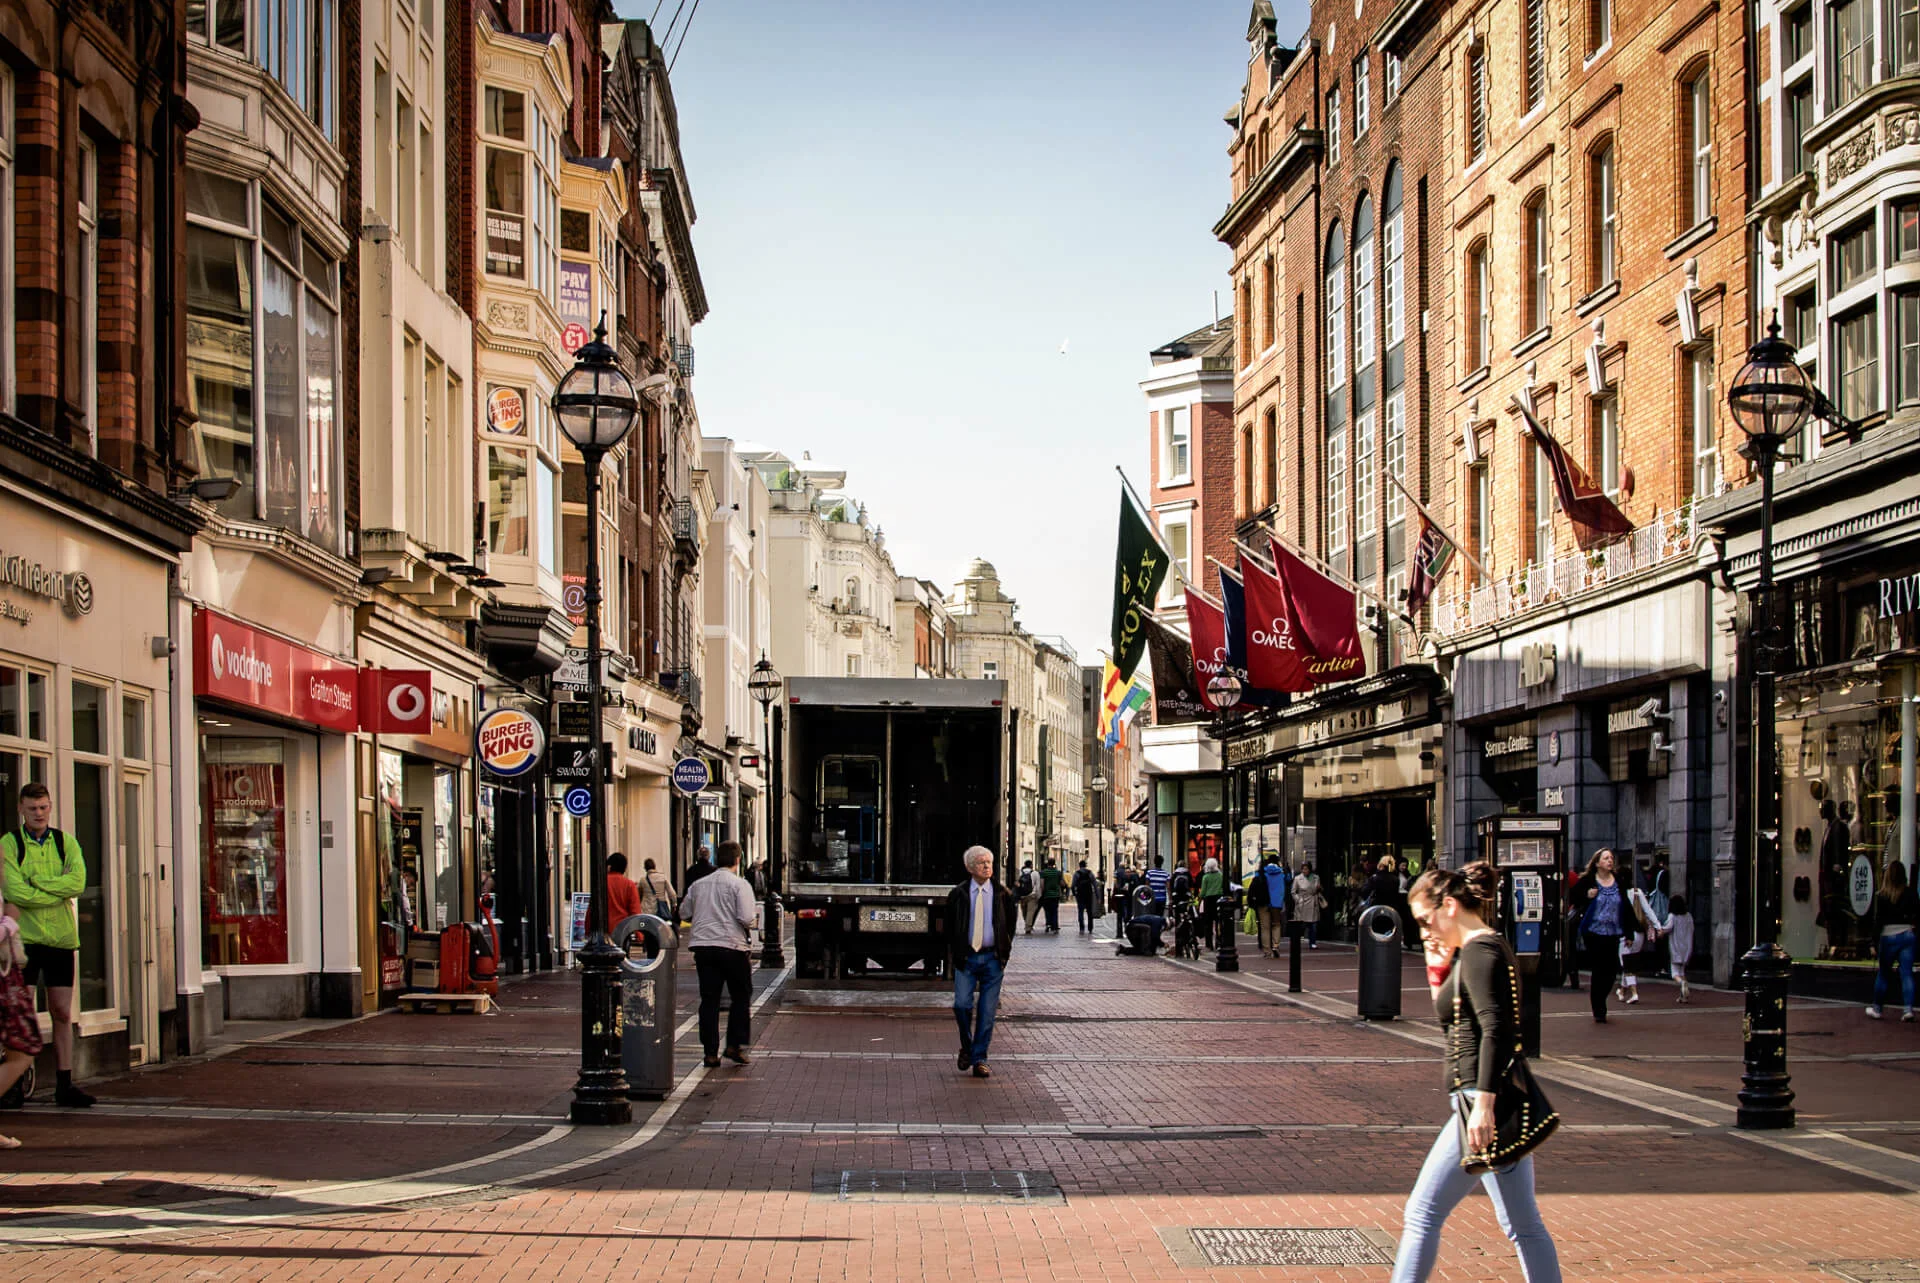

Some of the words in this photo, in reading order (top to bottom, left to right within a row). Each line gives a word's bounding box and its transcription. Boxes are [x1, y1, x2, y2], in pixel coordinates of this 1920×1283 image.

[561, 271, 588, 289] PAY
[573, 289, 588, 299] YOU
[561, 300, 588, 318] TAN
[26, 560, 65, 601] Ireland
[1879, 572, 1920, 619] RIV
[1519, 642, 1557, 688] AIB
[226, 646, 272, 687] vodafone
[310, 676, 334, 705] Grafton
[333, 684, 352, 710] Street
[482, 722, 532, 744] BURGER
[484, 733, 534, 761] KING
[1486, 738, 1508, 757] Service
[1508, 735, 1529, 751] Centre
[676, 774, 706, 784] MATTERS
[678, 765, 704, 774] HEALTH
[223, 794, 266, 806] vodafone
[1544, 787, 1564, 808] Bank
[1855, 880, 1868, 891] OFF
